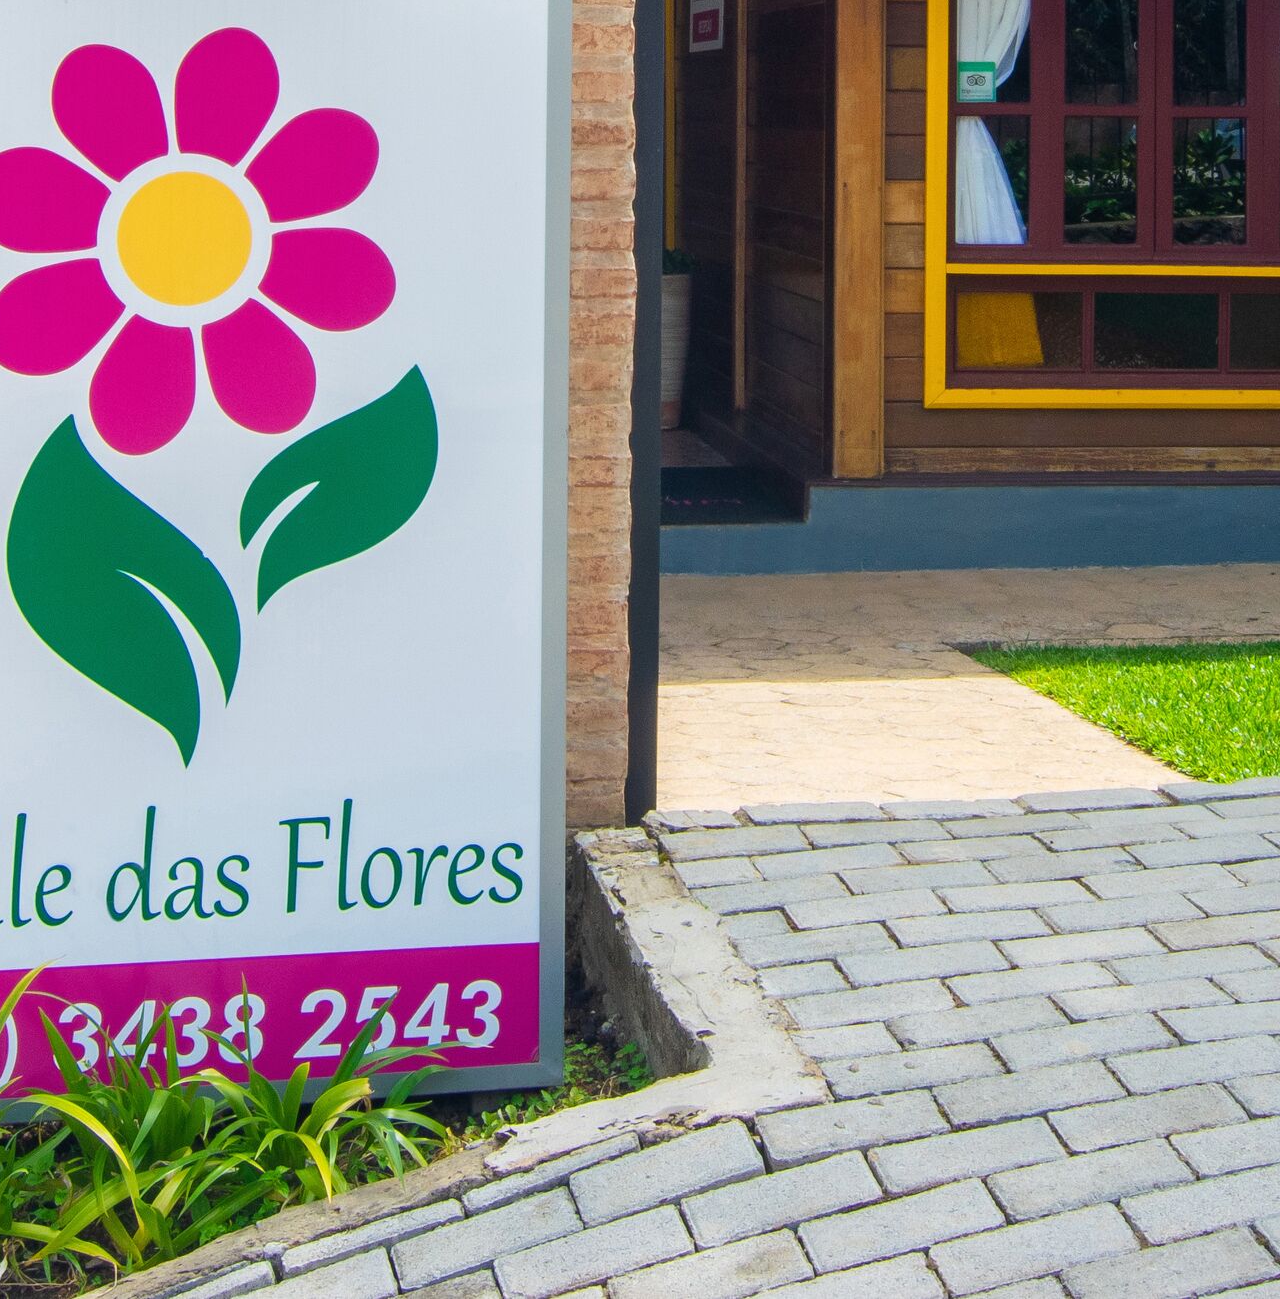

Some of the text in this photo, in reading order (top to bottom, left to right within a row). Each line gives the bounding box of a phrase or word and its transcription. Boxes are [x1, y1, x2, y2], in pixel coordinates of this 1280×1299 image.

[105, 805, 250, 922] das
[277, 797, 524, 915] Flores
[53, 993, 266, 1073] 3438
[293, 979, 503, 1059] 2543
